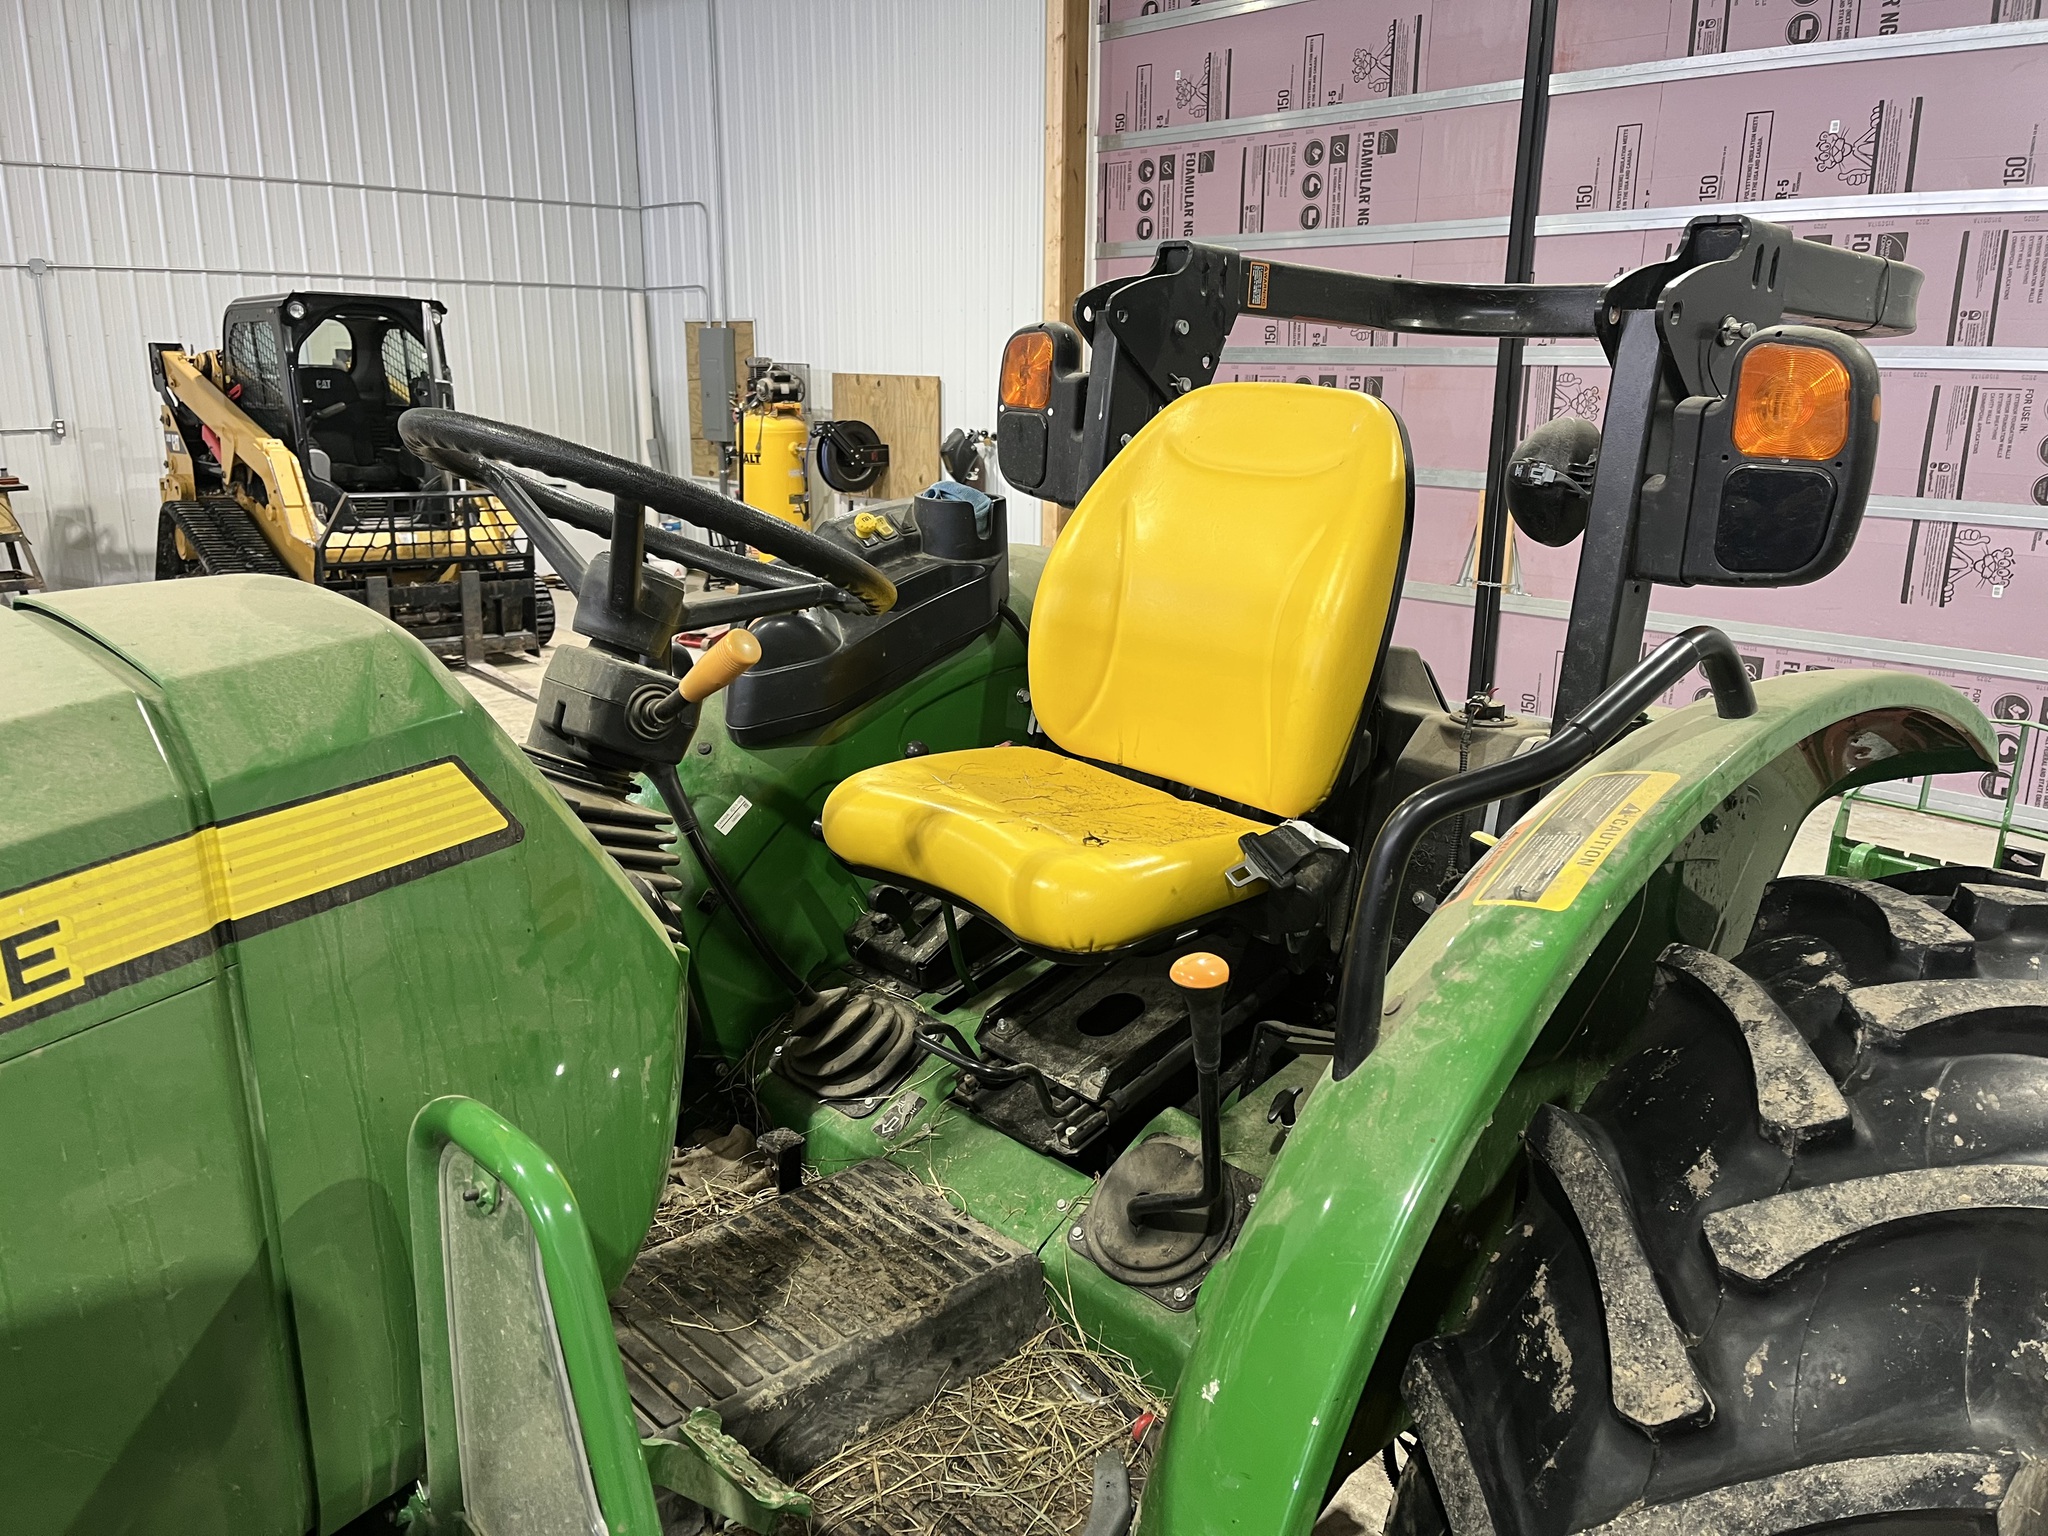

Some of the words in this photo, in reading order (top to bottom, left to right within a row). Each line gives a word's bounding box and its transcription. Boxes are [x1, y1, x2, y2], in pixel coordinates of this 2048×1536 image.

[1277, 89, 1290, 112] 150
[1328, 90, 1336, 106] R-5
[1115, 113, 1126, 133] 150
[1748, 133, 1756, 163] INSULATION
[2003, 156, 2028, 186] 150
[1576, 185, 1593, 210] 150
[1698, 175, 1718, 202] 150
[1774, 179, 1790, 200] R-5
[1357, 208, 1370, 226] NG
[1183, 221, 1194, 237] NG
[1264, 325, 1277, 345] 150
[315, 379, 331, 389] CAT
[2024, 388, 2034, 404] FOR
[2021, 406, 2031, 422] USE
[744, 453, 761, 464] ALT
[1520, 693, 1536, 714] 150
[1972, 688, 1982, 704] FOR
[1577, 818, 1629, 866] CAUTION
[0, 919, 71, 1002] E
